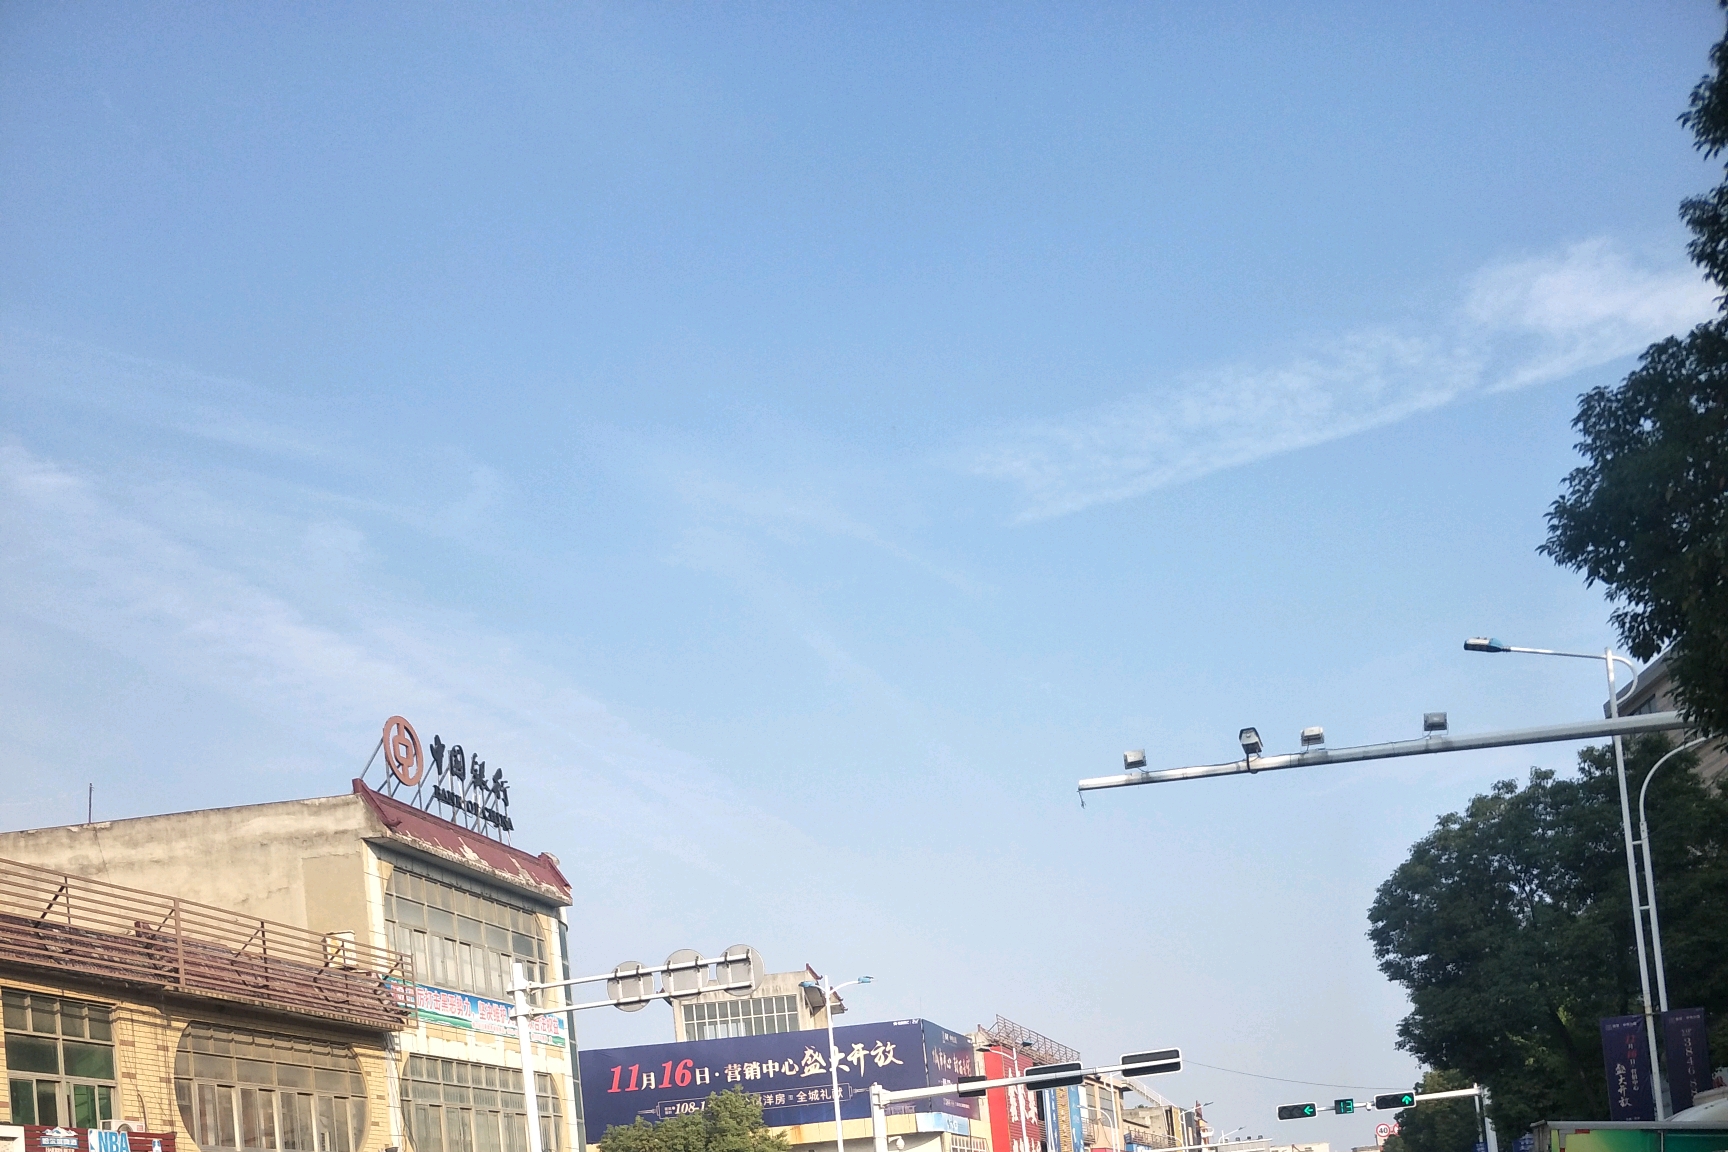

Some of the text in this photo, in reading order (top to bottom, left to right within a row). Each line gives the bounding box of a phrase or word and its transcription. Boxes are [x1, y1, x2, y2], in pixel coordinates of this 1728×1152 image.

[430, 735, 510, 806] 中国银行
[433, 785, 514, 831] BANK OF CHINA
[674, 1100, 706, 1115] 108-1
